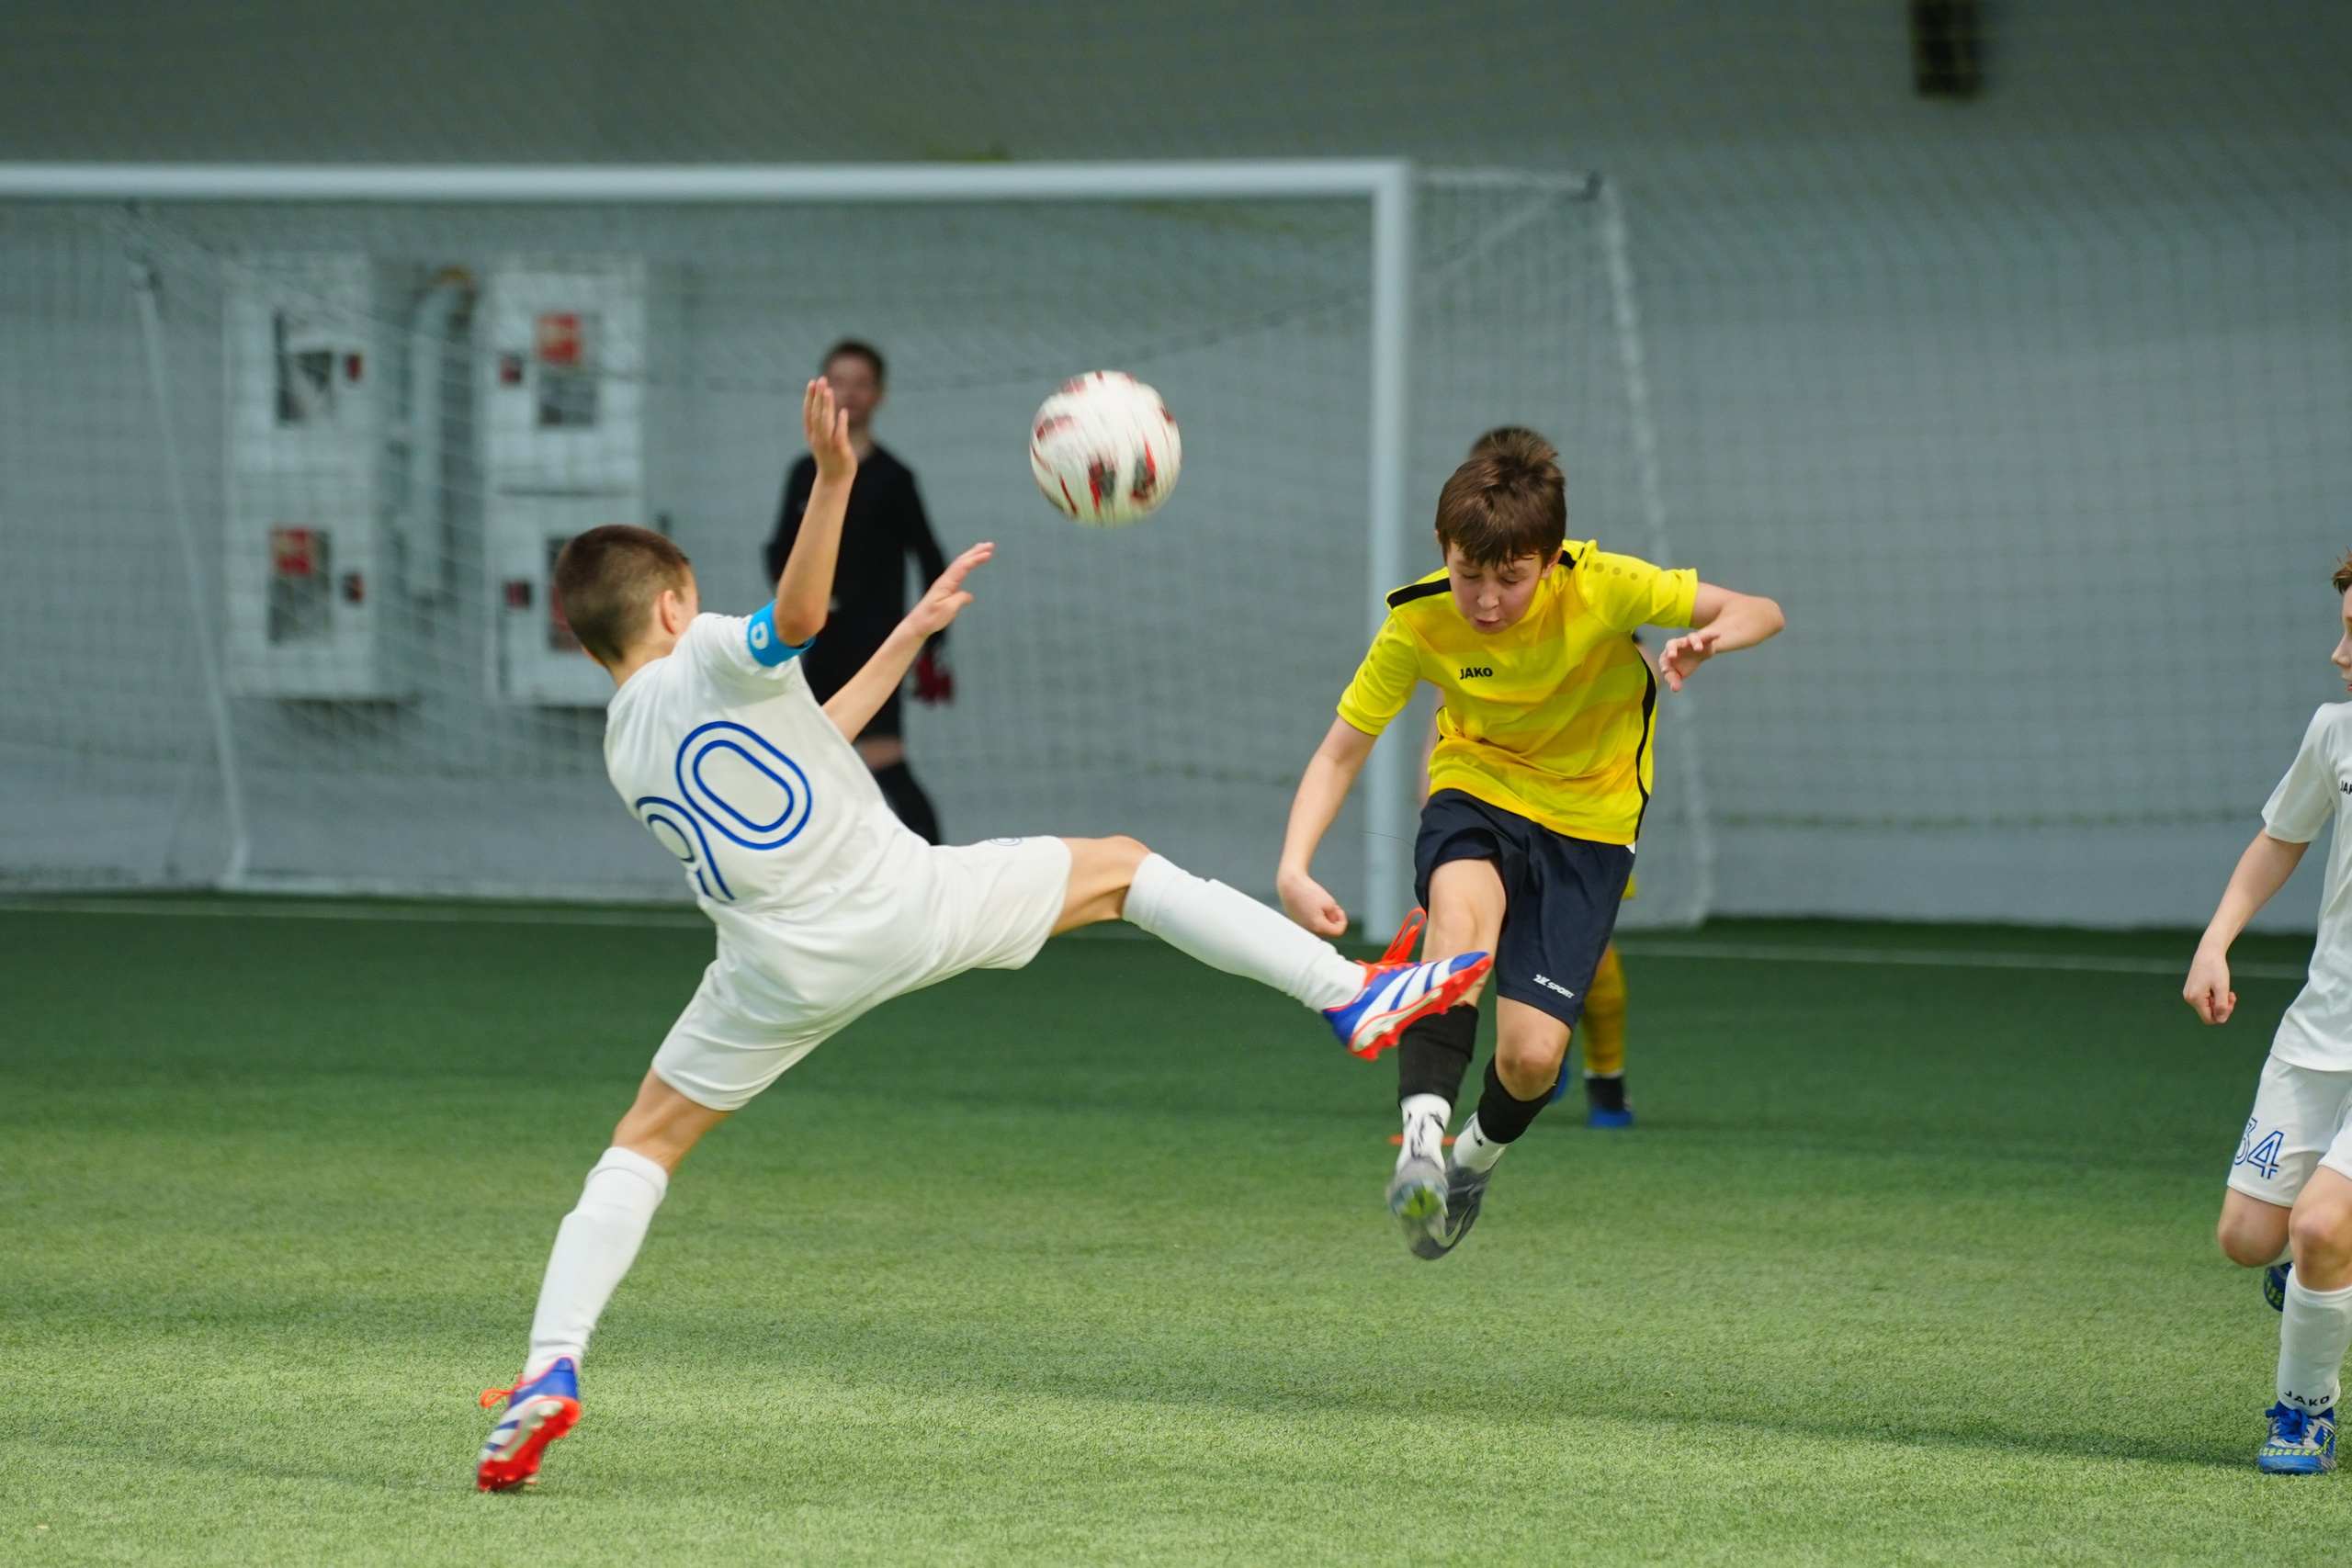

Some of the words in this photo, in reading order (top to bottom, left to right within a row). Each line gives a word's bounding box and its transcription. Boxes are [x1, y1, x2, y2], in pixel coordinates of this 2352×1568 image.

[1460, 667, 1494, 680] JAKO
[1546, 981, 1575, 999] SPORT
[2284, 1390, 2330, 1407] JAKO
